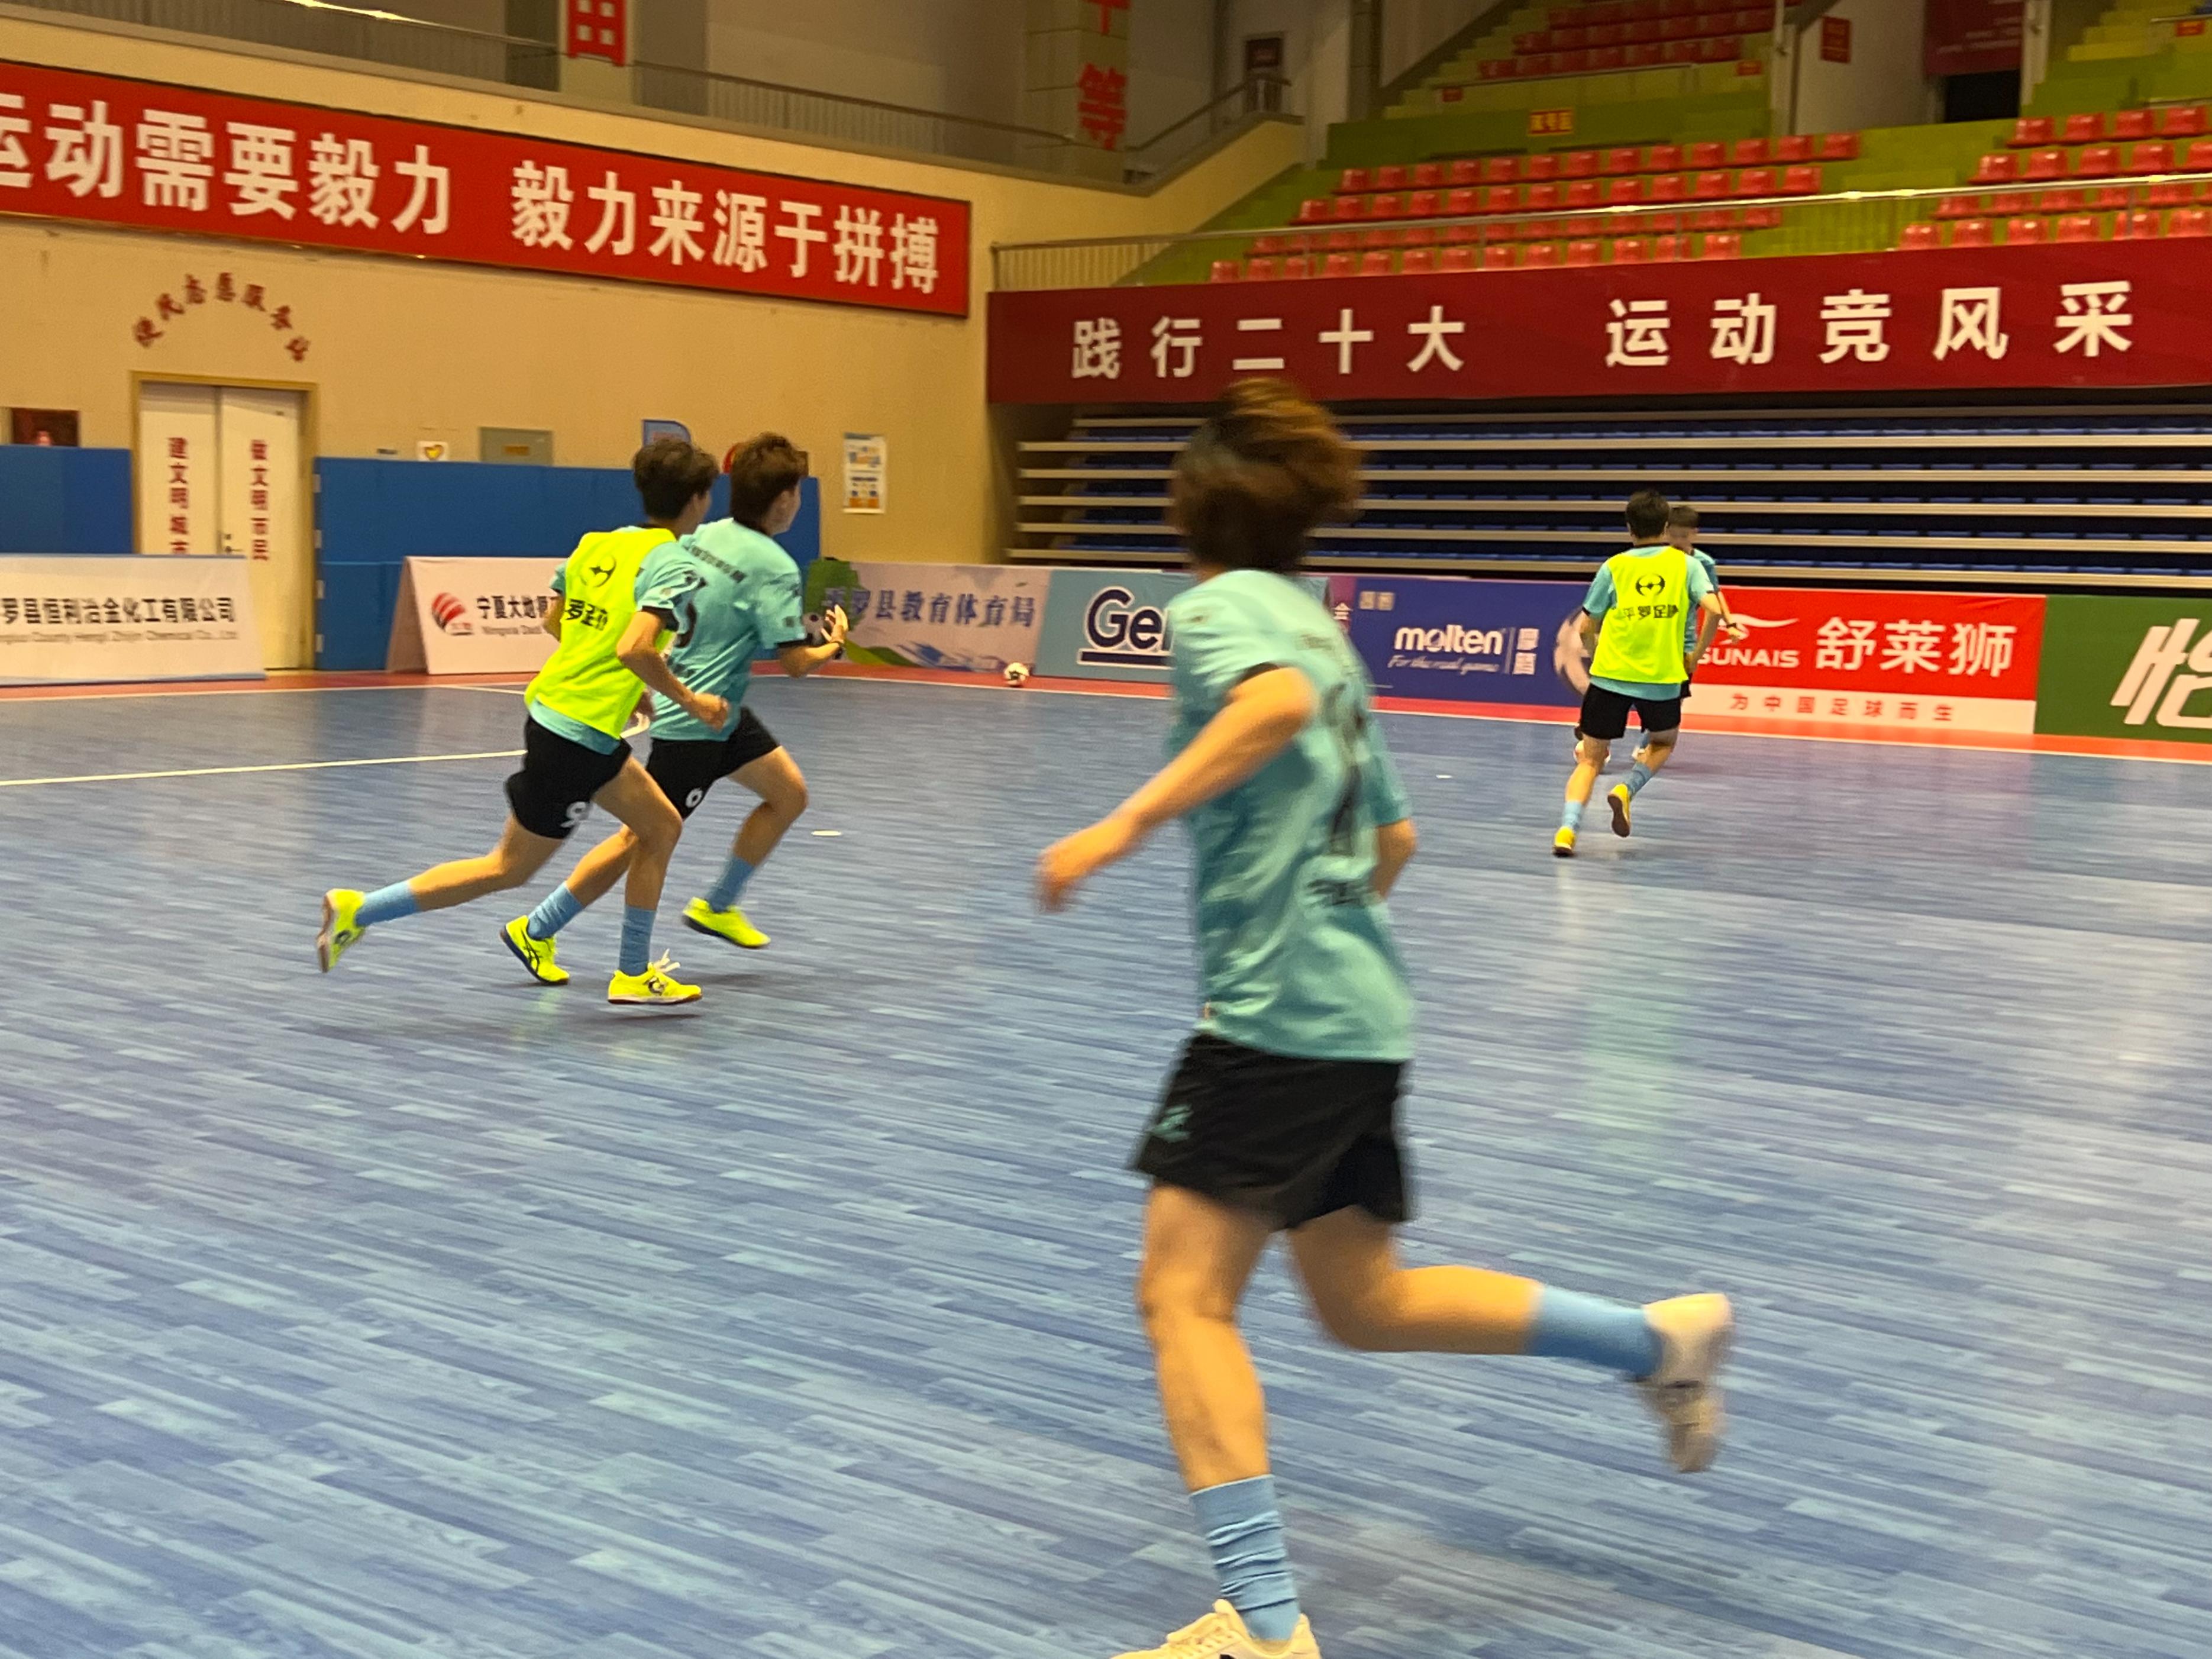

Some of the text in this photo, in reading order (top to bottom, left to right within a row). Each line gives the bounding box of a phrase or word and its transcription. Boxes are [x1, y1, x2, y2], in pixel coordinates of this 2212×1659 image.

[511, 160, 939, 295] 毅力来源于拼搏
[1071, 280, 2133, 379] 践行二十大 运动竞风采
[1394, 624, 1503, 655] molten
[1697, 647, 1800, 669] SUNAIS
[1816, 616, 2017, 678] 舒莱狮
[1730, 693, 1956, 722] 为中国足球而生
